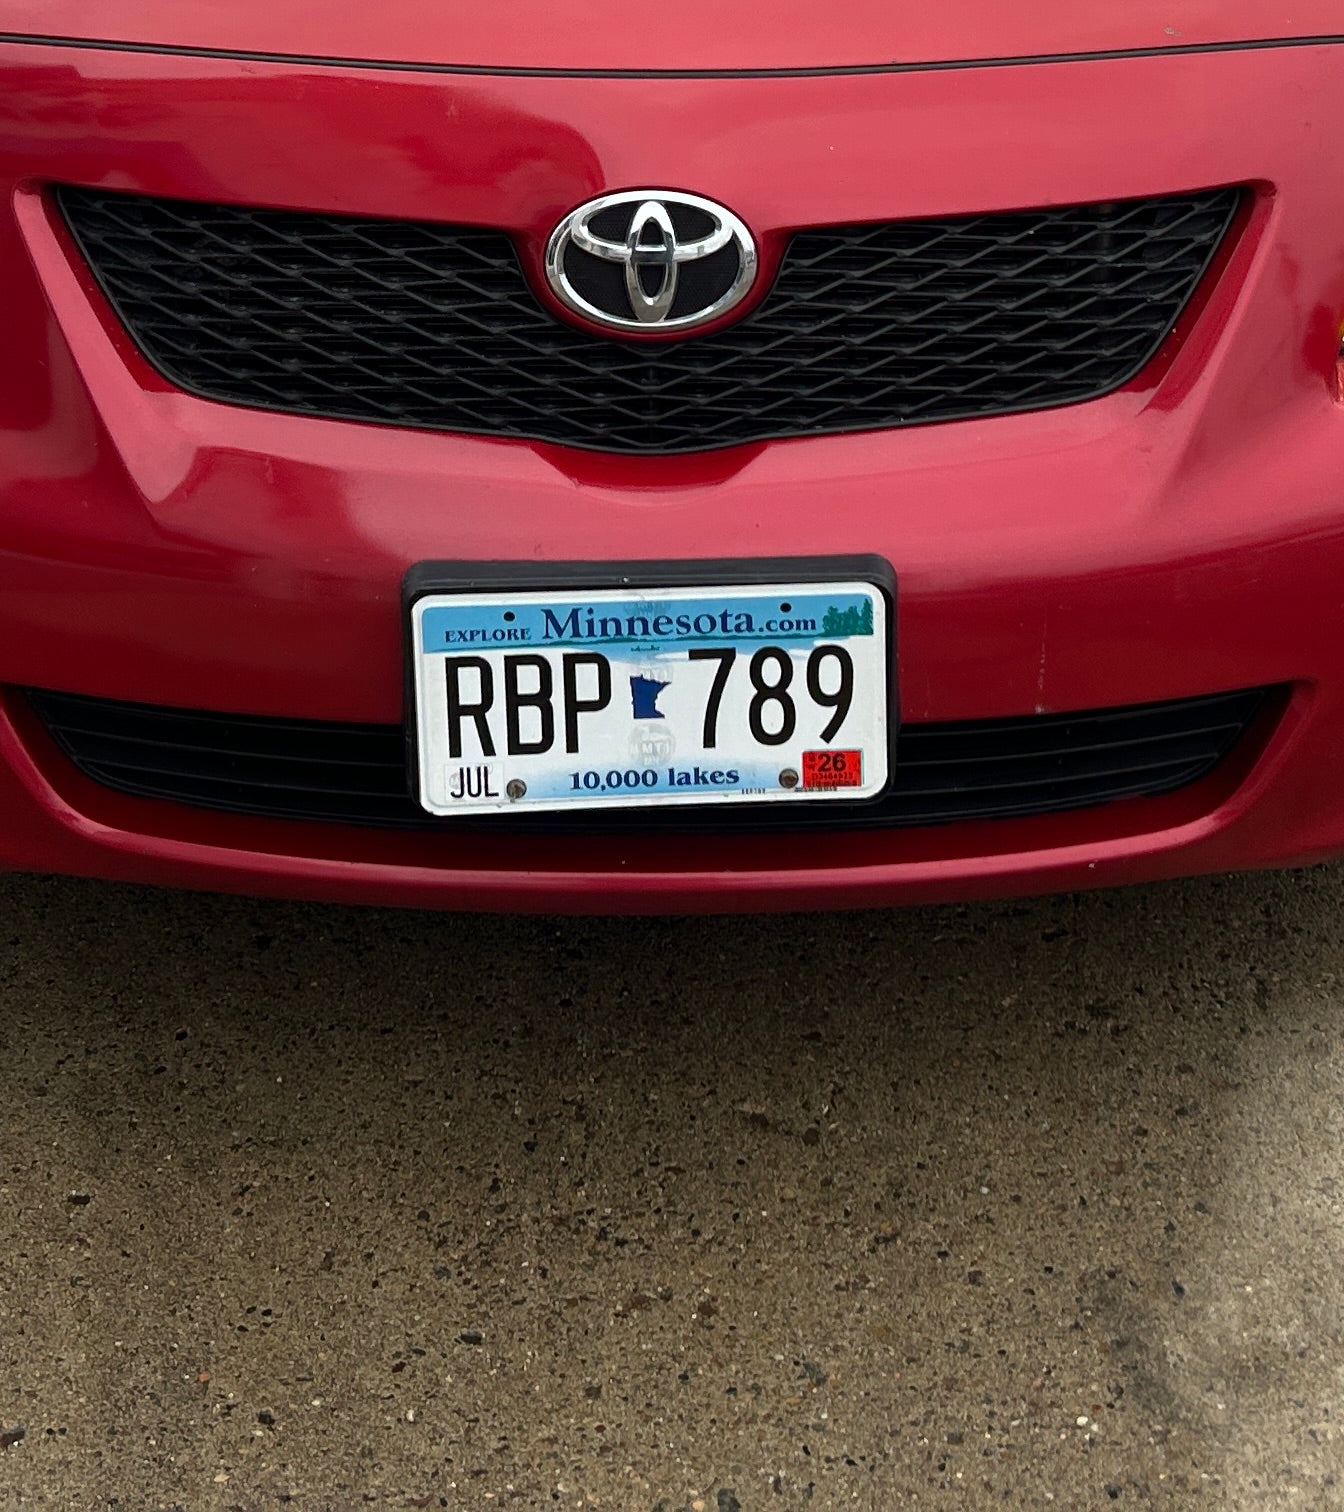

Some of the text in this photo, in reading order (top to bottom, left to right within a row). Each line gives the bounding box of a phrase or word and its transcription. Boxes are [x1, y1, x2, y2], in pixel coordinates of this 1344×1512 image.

[444, 607, 817, 643] EXPLORE Minnesota.com
[444, 644, 855, 759] RBP 789
[569, 766, 740, 792] 10,000 lakes
[817, 753, 847, 772] 26
[450, 766, 500, 799] JUL
